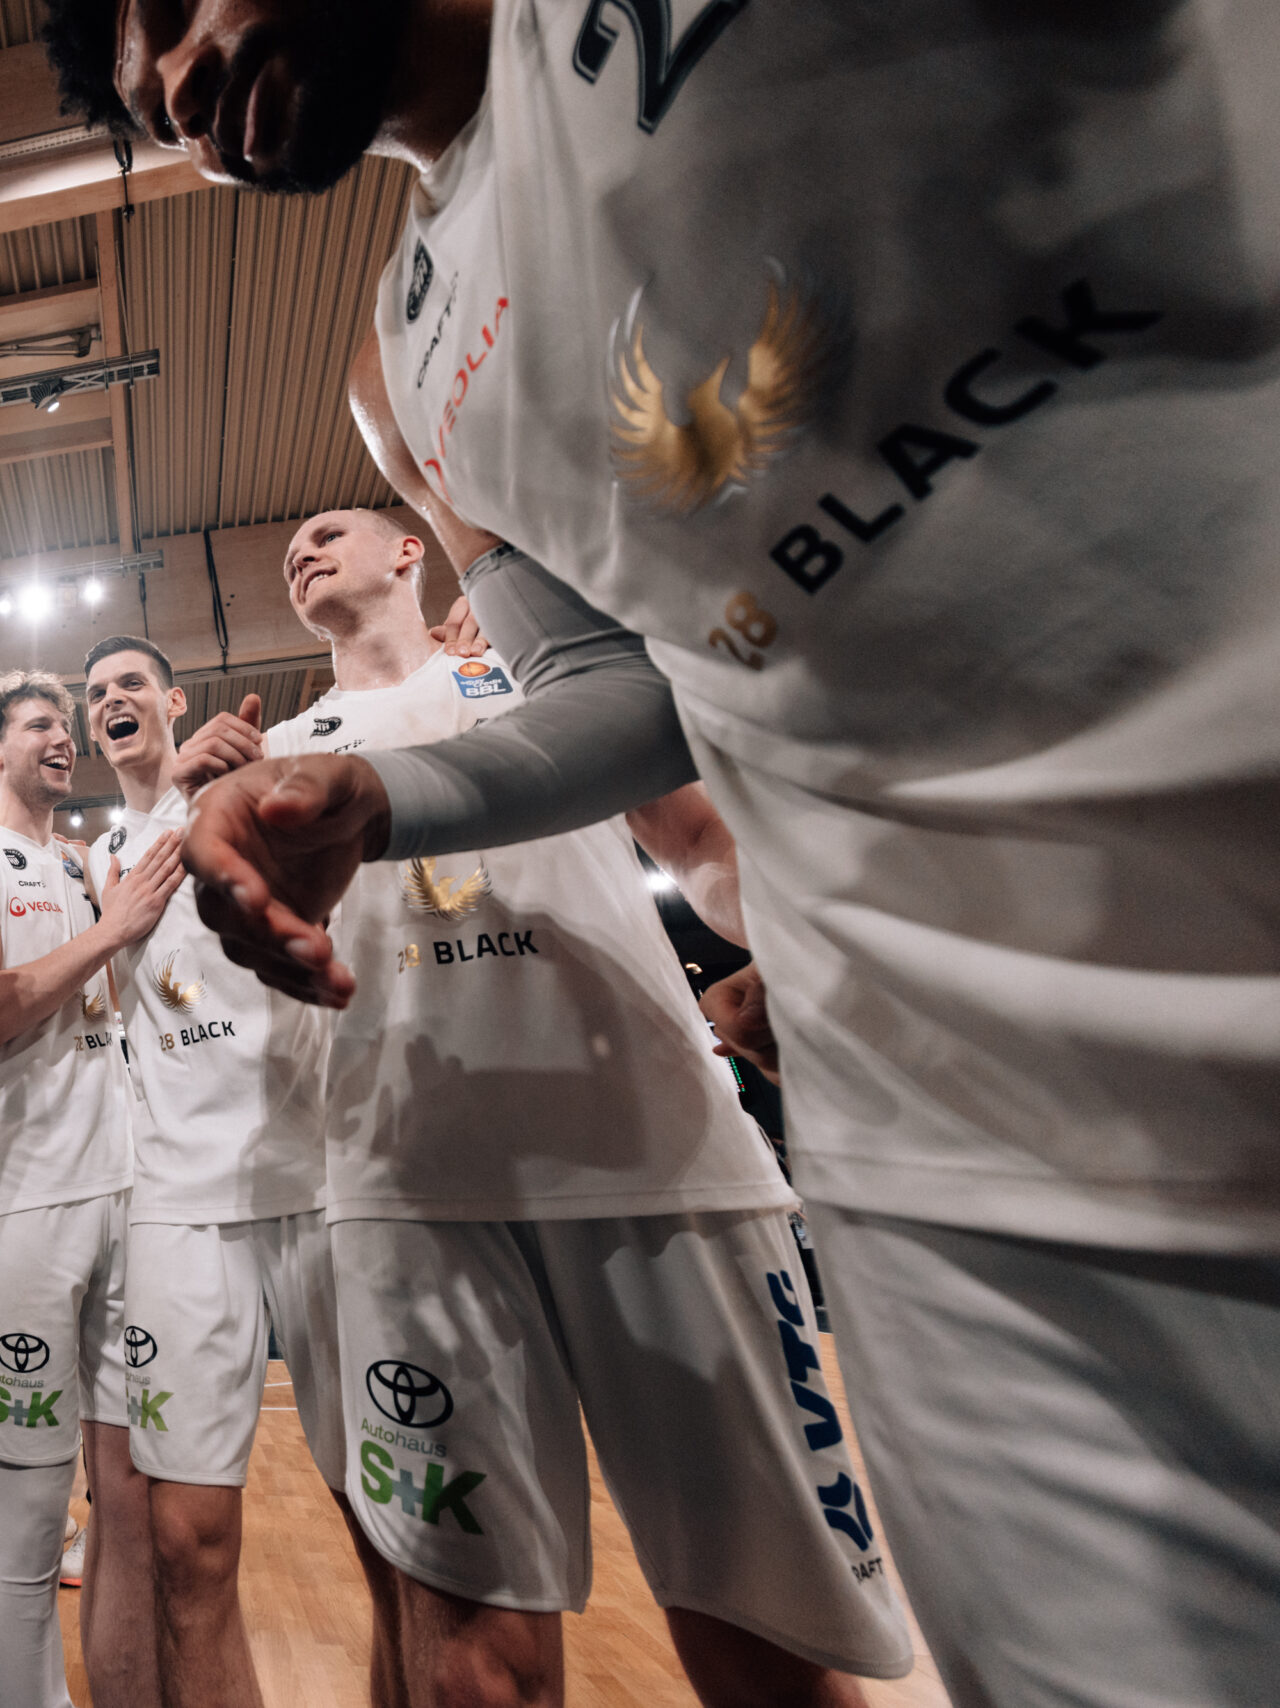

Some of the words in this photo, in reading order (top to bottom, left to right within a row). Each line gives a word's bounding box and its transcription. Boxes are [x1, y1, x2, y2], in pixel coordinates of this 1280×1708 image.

[709, 591, 778, 671] 28
[769, 277, 1163, 596] BLACK
[466, 683, 506, 696] BBL
[26, 901, 64, 913] VEOLIA
[397, 943, 420, 975] 28
[433, 930, 539, 965] BLACK
[159, 1033, 175, 1051] 28
[180, 1021, 236, 1047] BLACK
[361, 1417, 447, 1458] Autohaus
[360, 1440, 488, 1536] S+K
[851, 1556, 884, 1585] RAFT
